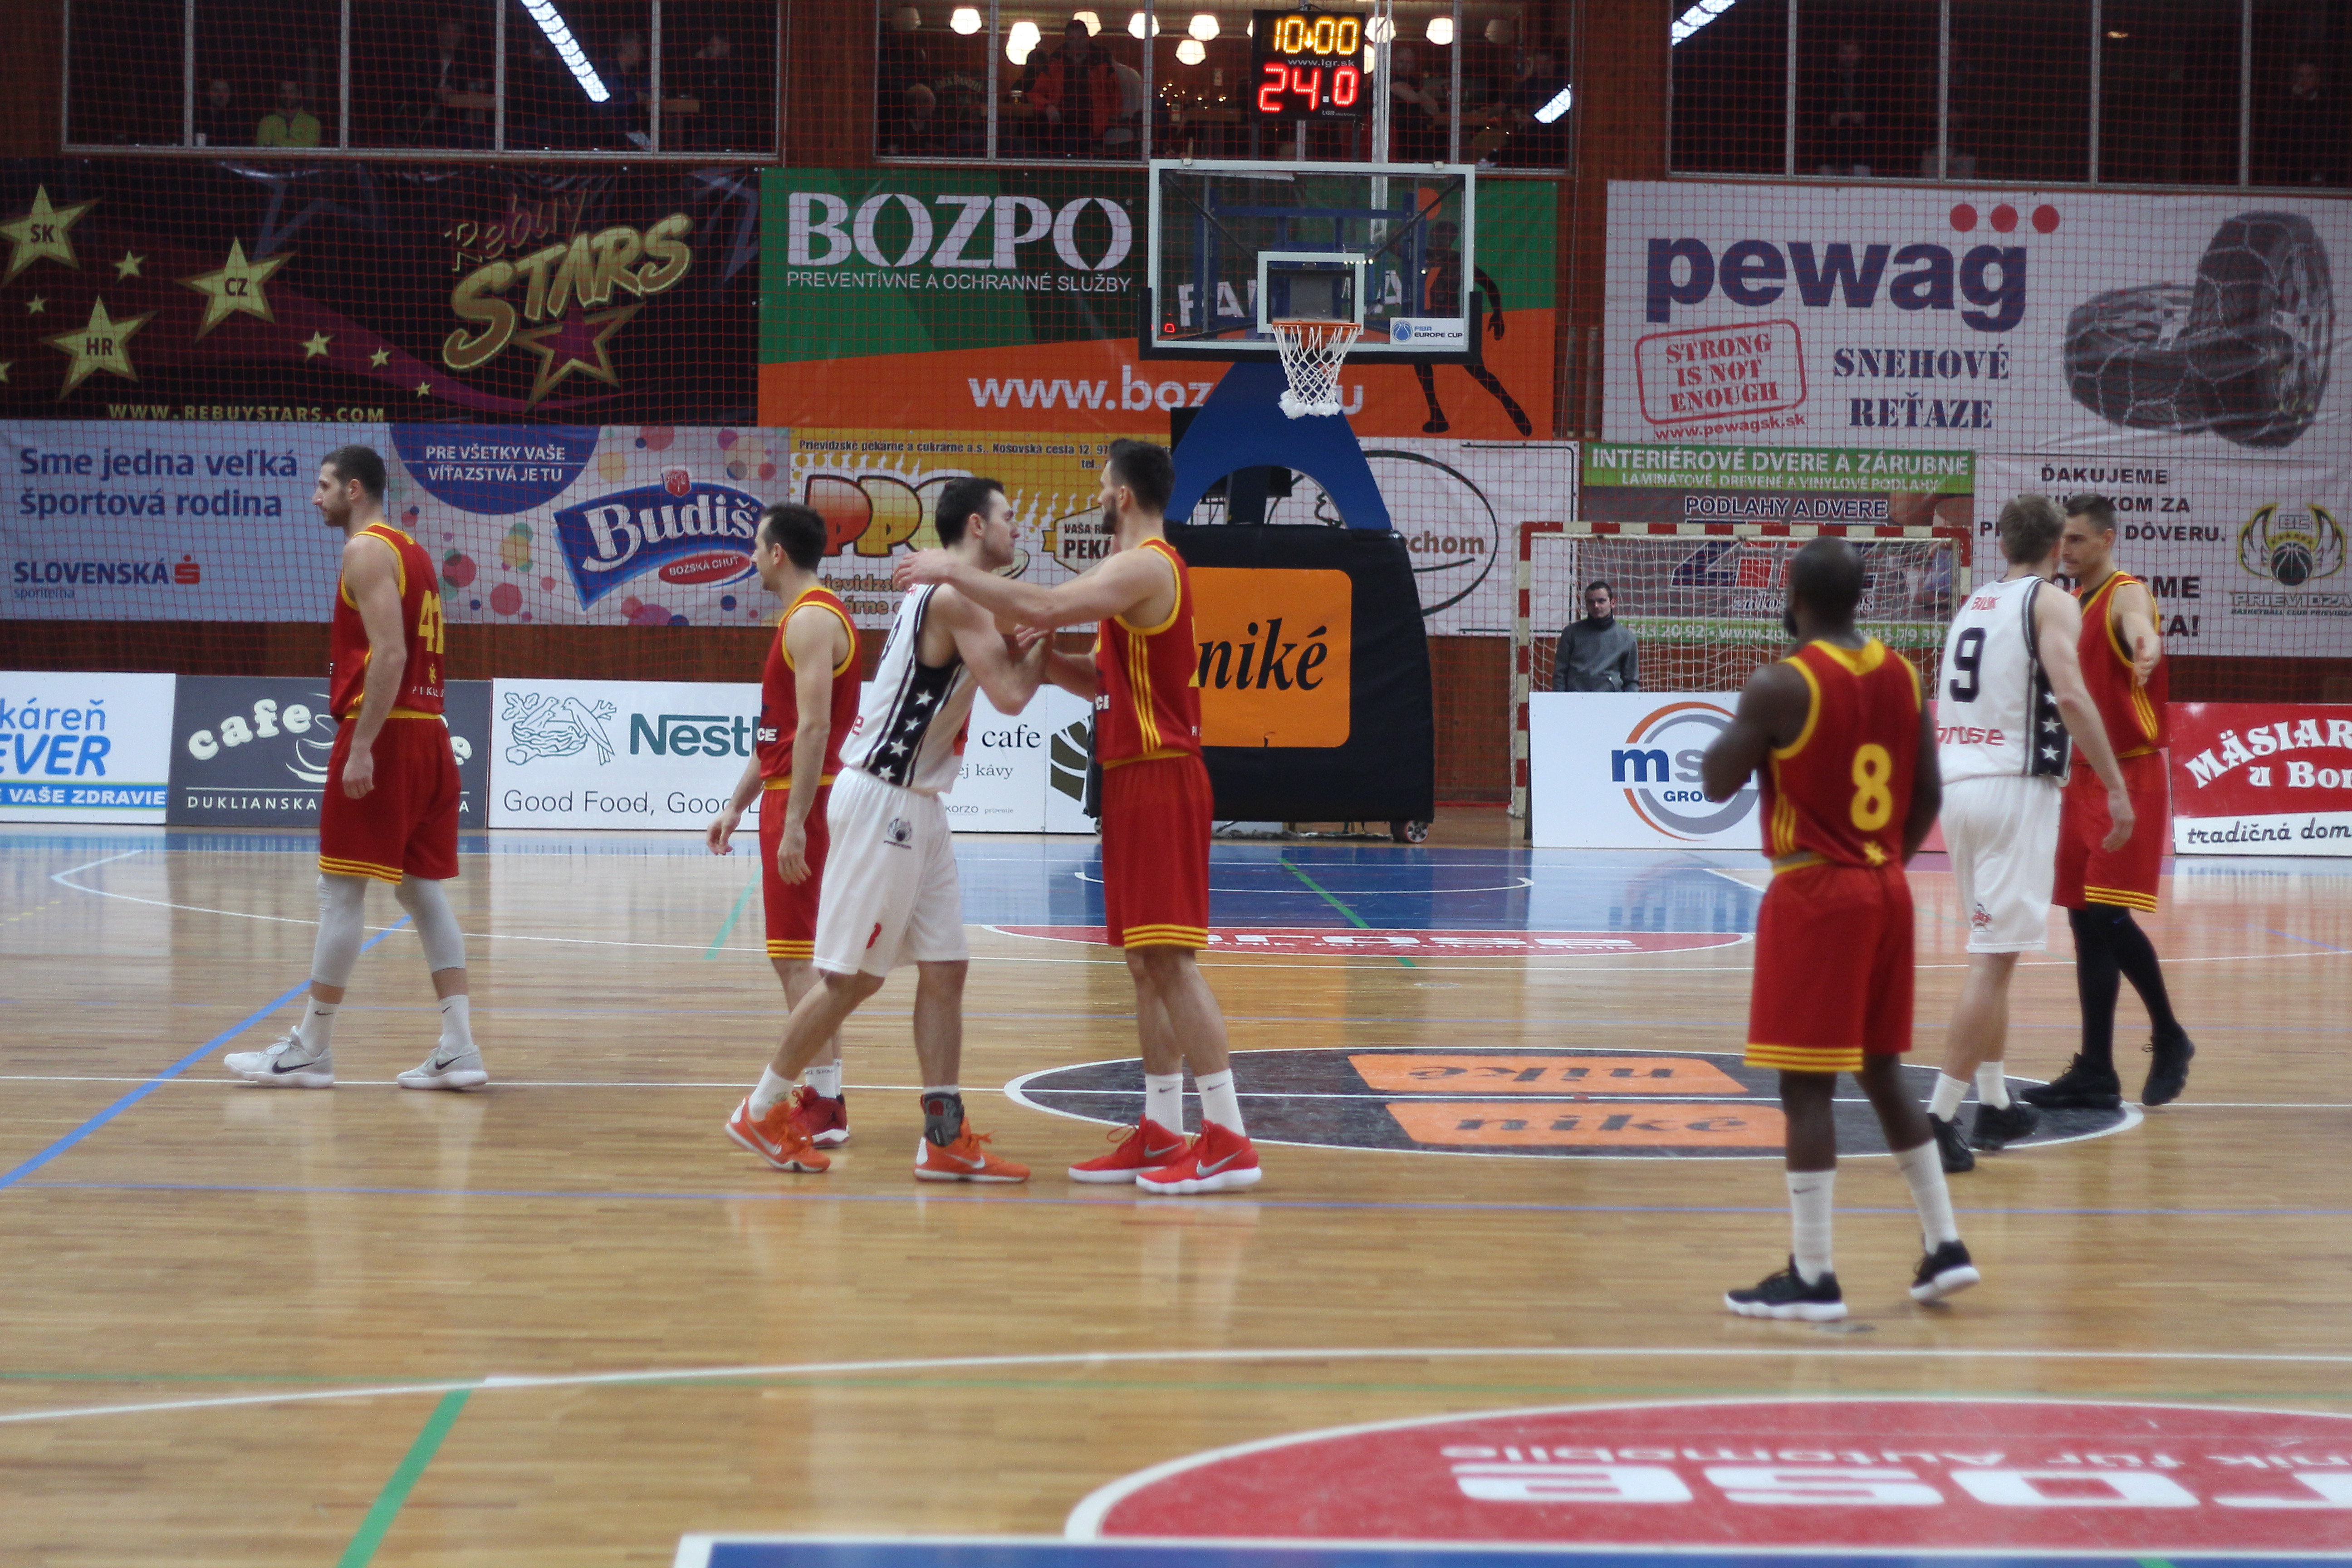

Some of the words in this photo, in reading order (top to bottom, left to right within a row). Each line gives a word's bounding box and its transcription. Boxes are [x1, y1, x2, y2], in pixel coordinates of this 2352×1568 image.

[1288, 59, 1355, 68] www.lgr.sk
[30, 224, 55, 243] SK
[788, 192, 1132, 271] BOZPO
[225, 278, 248, 297] CZ
[443, 213, 694, 371] STARS
[787, 270, 920, 289] PREVENTÍVNE
[926, 274, 939, 289] A
[943, 272, 1049, 290] OCHRANNÉ
[1057, 274, 1132, 293] SLUŽBY
[1646, 238, 2027, 332] pewag
[86, 337, 113, 356] HR
[1666, 333, 1771, 364] STRONG
[1675, 366, 1702, 387] IS
[1709, 359, 1762, 383] NOT
[1833, 344, 2009, 379] SNEHOVÉ
[1670, 382, 1779, 412] ENOUGH
[1849, 392, 1993, 428] REŤAZE
[109, 404, 384, 422] WWW.REBUYSTARS.COM
[1655, 413, 1806, 441] www.pewagsk.sk
[426, 445, 456, 460] PRE
[459, 443, 521, 460] VŠETKY
[524, 444, 565, 461] VAŠE
[862, 441, 904, 453] pekárne
[916, 442, 963, 452] cukrárne
[1046, 446, 1074, 455] cesta
[1096, 446, 1108, 455] 97
[1593, 446, 1745, 470] INTERIÉROVÉ
[1753, 451, 1828, 472] DVERE
[1836, 454, 1849, 473] A
[1858, 451, 1969, 475] ZÁRUBNE
[20, 448, 100, 475] Sme
[101, 449, 193, 481] jedna
[206, 449, 297, 477] veľká
[520, 467, 538, 482] JE
[540, 468, 563, 482] TU
[2041, 466, 2168, 484] ĎAKUJEME
[1788, 476, 1798, 489] A
[1872, 478, 1940, 492] PODLAHY
[20, 488, 166, 519] športová
[177, 489, 282, 516] rodina
[1685, 496, 1788, 517] PODLAHY
[1794, 499, 1810, 517] A
[1814, 499, 1888, 518] DVERE
[2161, 497, 2190, 513] ZA
[582, 494, 756, 571] Budiš
[2125, 522, 2226, 542] DÔVERU.
[14, 558, 169, 584] SLOVENSKÁ
[418, 590, 444, 654] 41
[1199, 617, 1328, 691] niké
[1950, 627, 1987, 703] 9
[0, 697, 106, 731] káreň
[187, 698, 312, 761] cafe
[630, 713, 761, 757] Nestl
[982, 724, 1041, 748] cafe
[1612, 749, 1751, 783] ms
[2185, 718, 2352, 789] MÄSIAR
[976, 764, 1014, 779] kávy
[2249, 766, 2272, 787] u
[9, 785, 65, 804] VAŠE
[71, 789, 166, 806] ZDRAVIE
[1663, 791, 1715, 802] GRO
[1850, 743, 1893, 831] 8
[187, 796, 317, 810] DUKLIANSKA
[504, 789, 573, 813] Good
[585, 791, 655, 816] Food,
[2187, 820, 2292, 844] tradičná
[2301, 817, 2352, 839] dom
